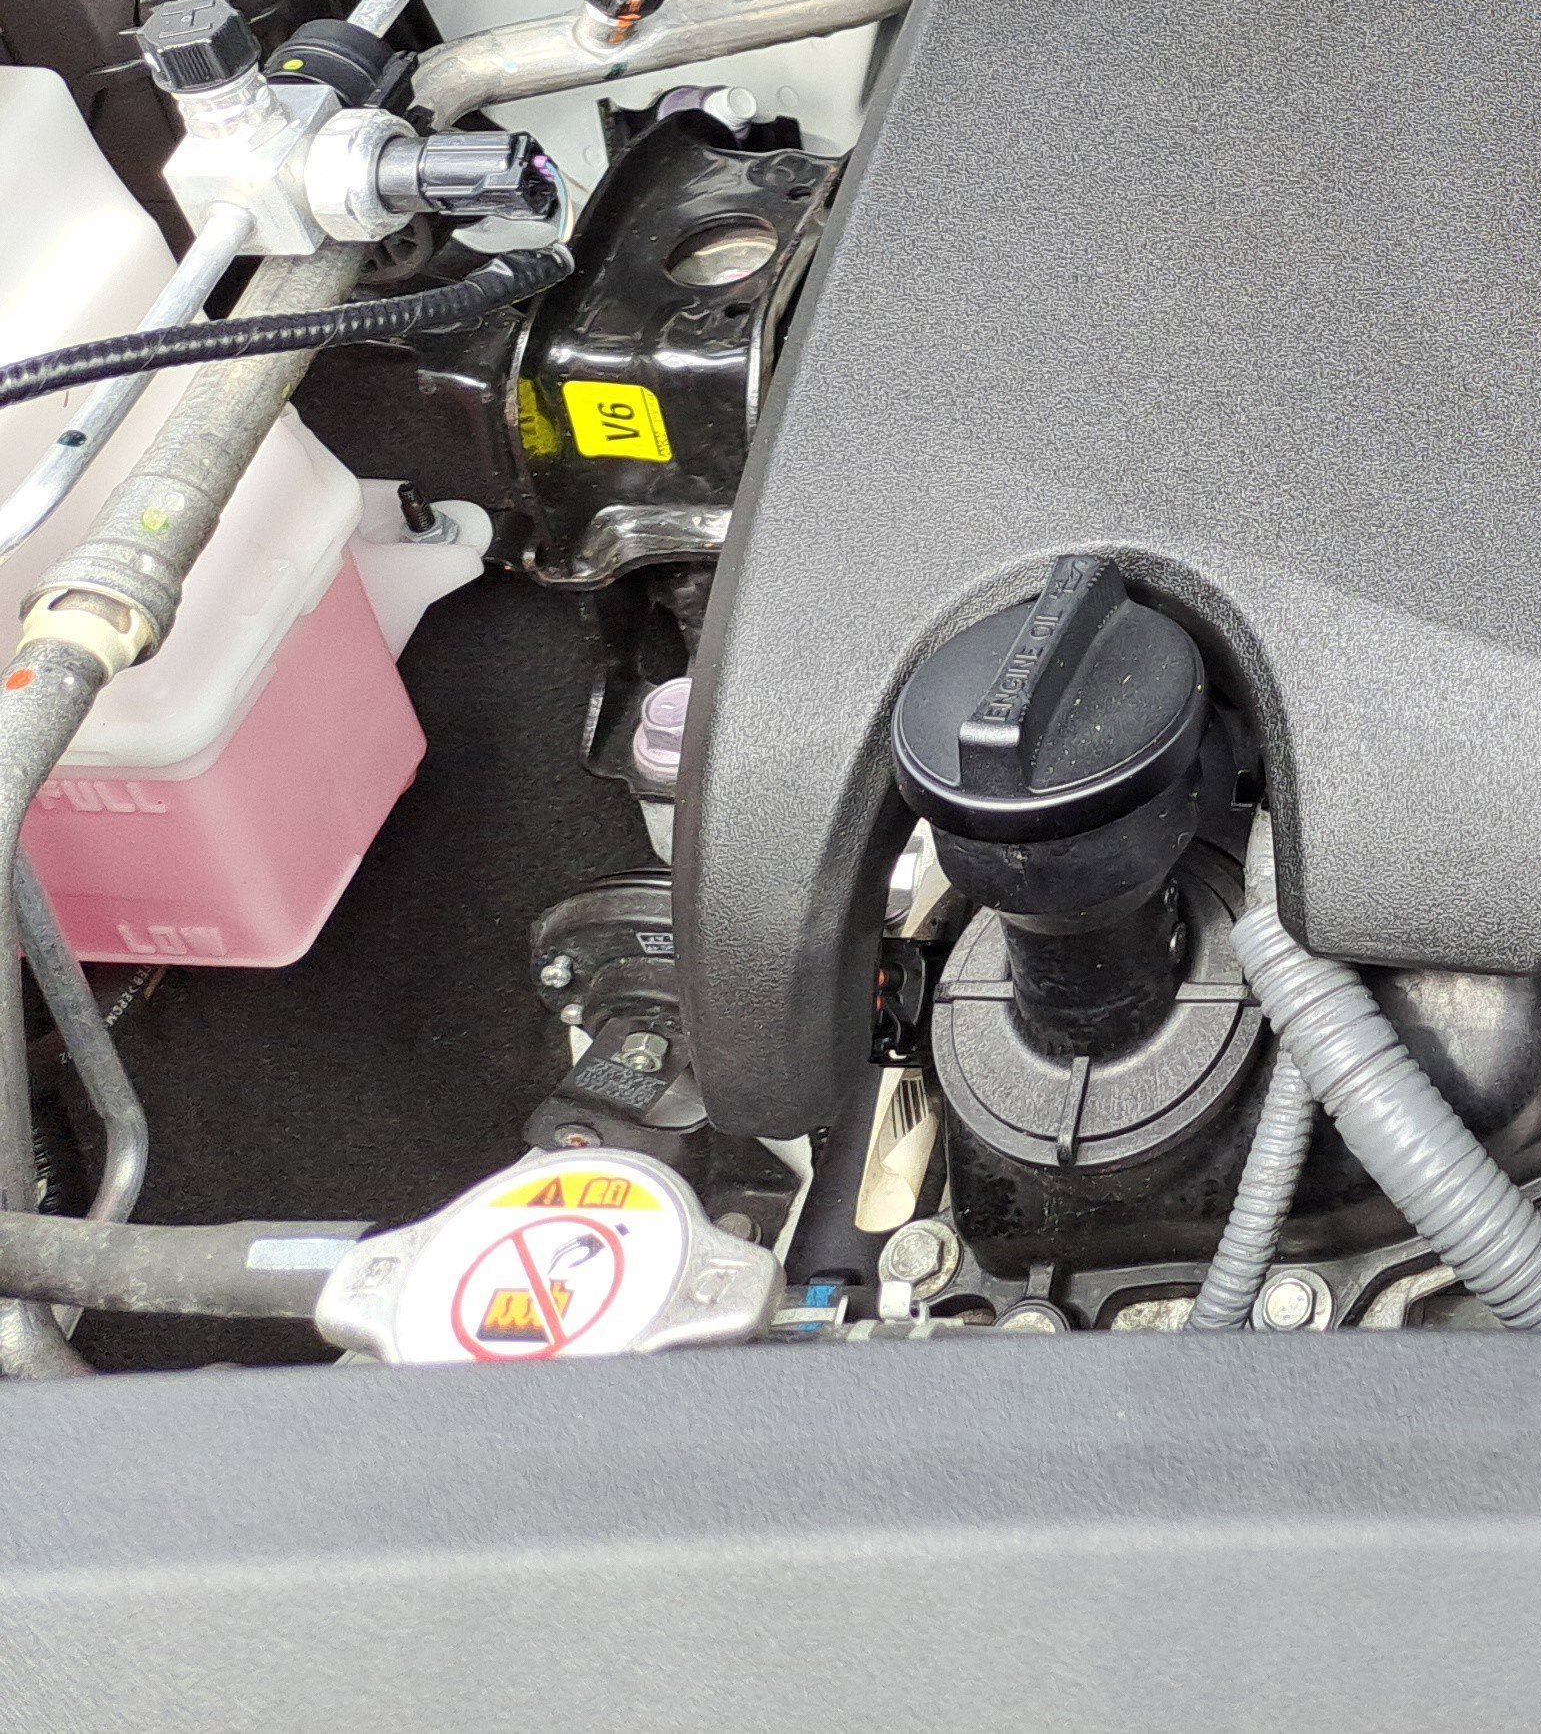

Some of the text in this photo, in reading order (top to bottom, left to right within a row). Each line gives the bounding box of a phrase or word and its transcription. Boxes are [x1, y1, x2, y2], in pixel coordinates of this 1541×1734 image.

[597, 401, 641, 442] V6
[983, 611, 1064, 722] ENGINE OIL
[37, 779, 168, 814] FULL
[117, 923, 228, 957] LOW
